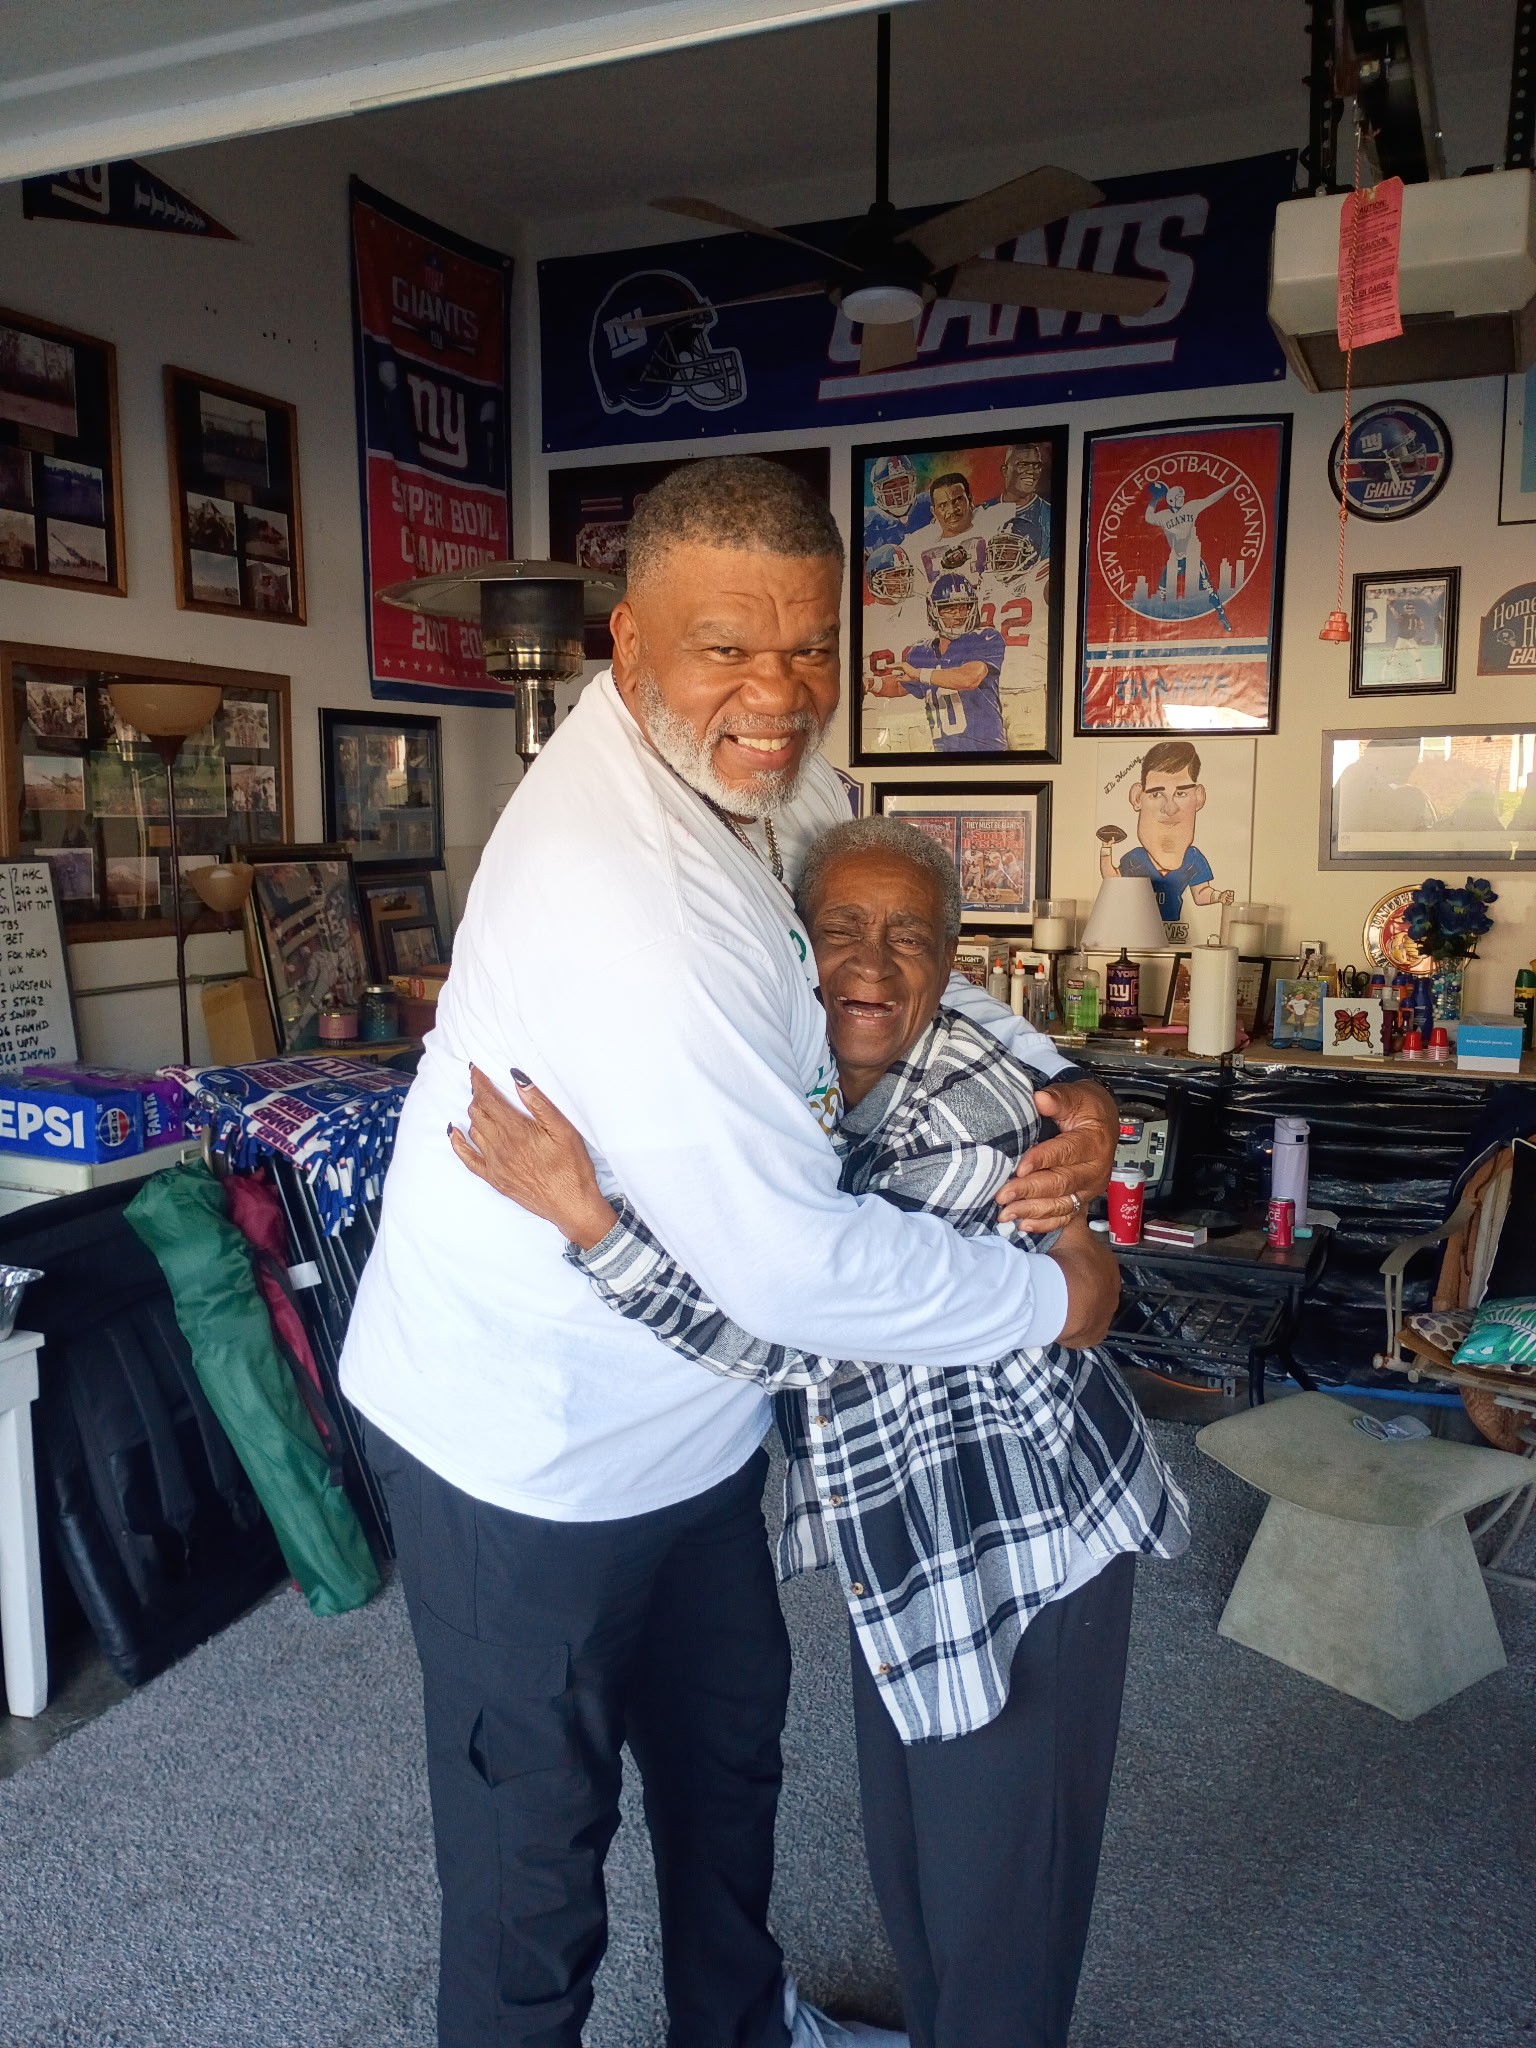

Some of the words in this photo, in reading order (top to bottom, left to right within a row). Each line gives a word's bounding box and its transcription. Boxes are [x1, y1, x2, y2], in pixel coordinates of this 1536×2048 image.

[392, 276, 479, 341] GIANTS
[1133, 456, 1229, 490] FOOTBALL
[1364, 480, 1416, 499] GIANTS
[450, 498, 499, 540] BOWL
[1102, 489, 1136, 543] YORK
[1165, 514, 1194, 530] GIANTS
[1233, 483, 1261, 559] GIANTS
[1103, 551, 1132, 594] NEW
[22, 868, 43, 880] ABC
[3, 932, 24, 945] BET
[143, 1093, 162, 1137] FANTA
